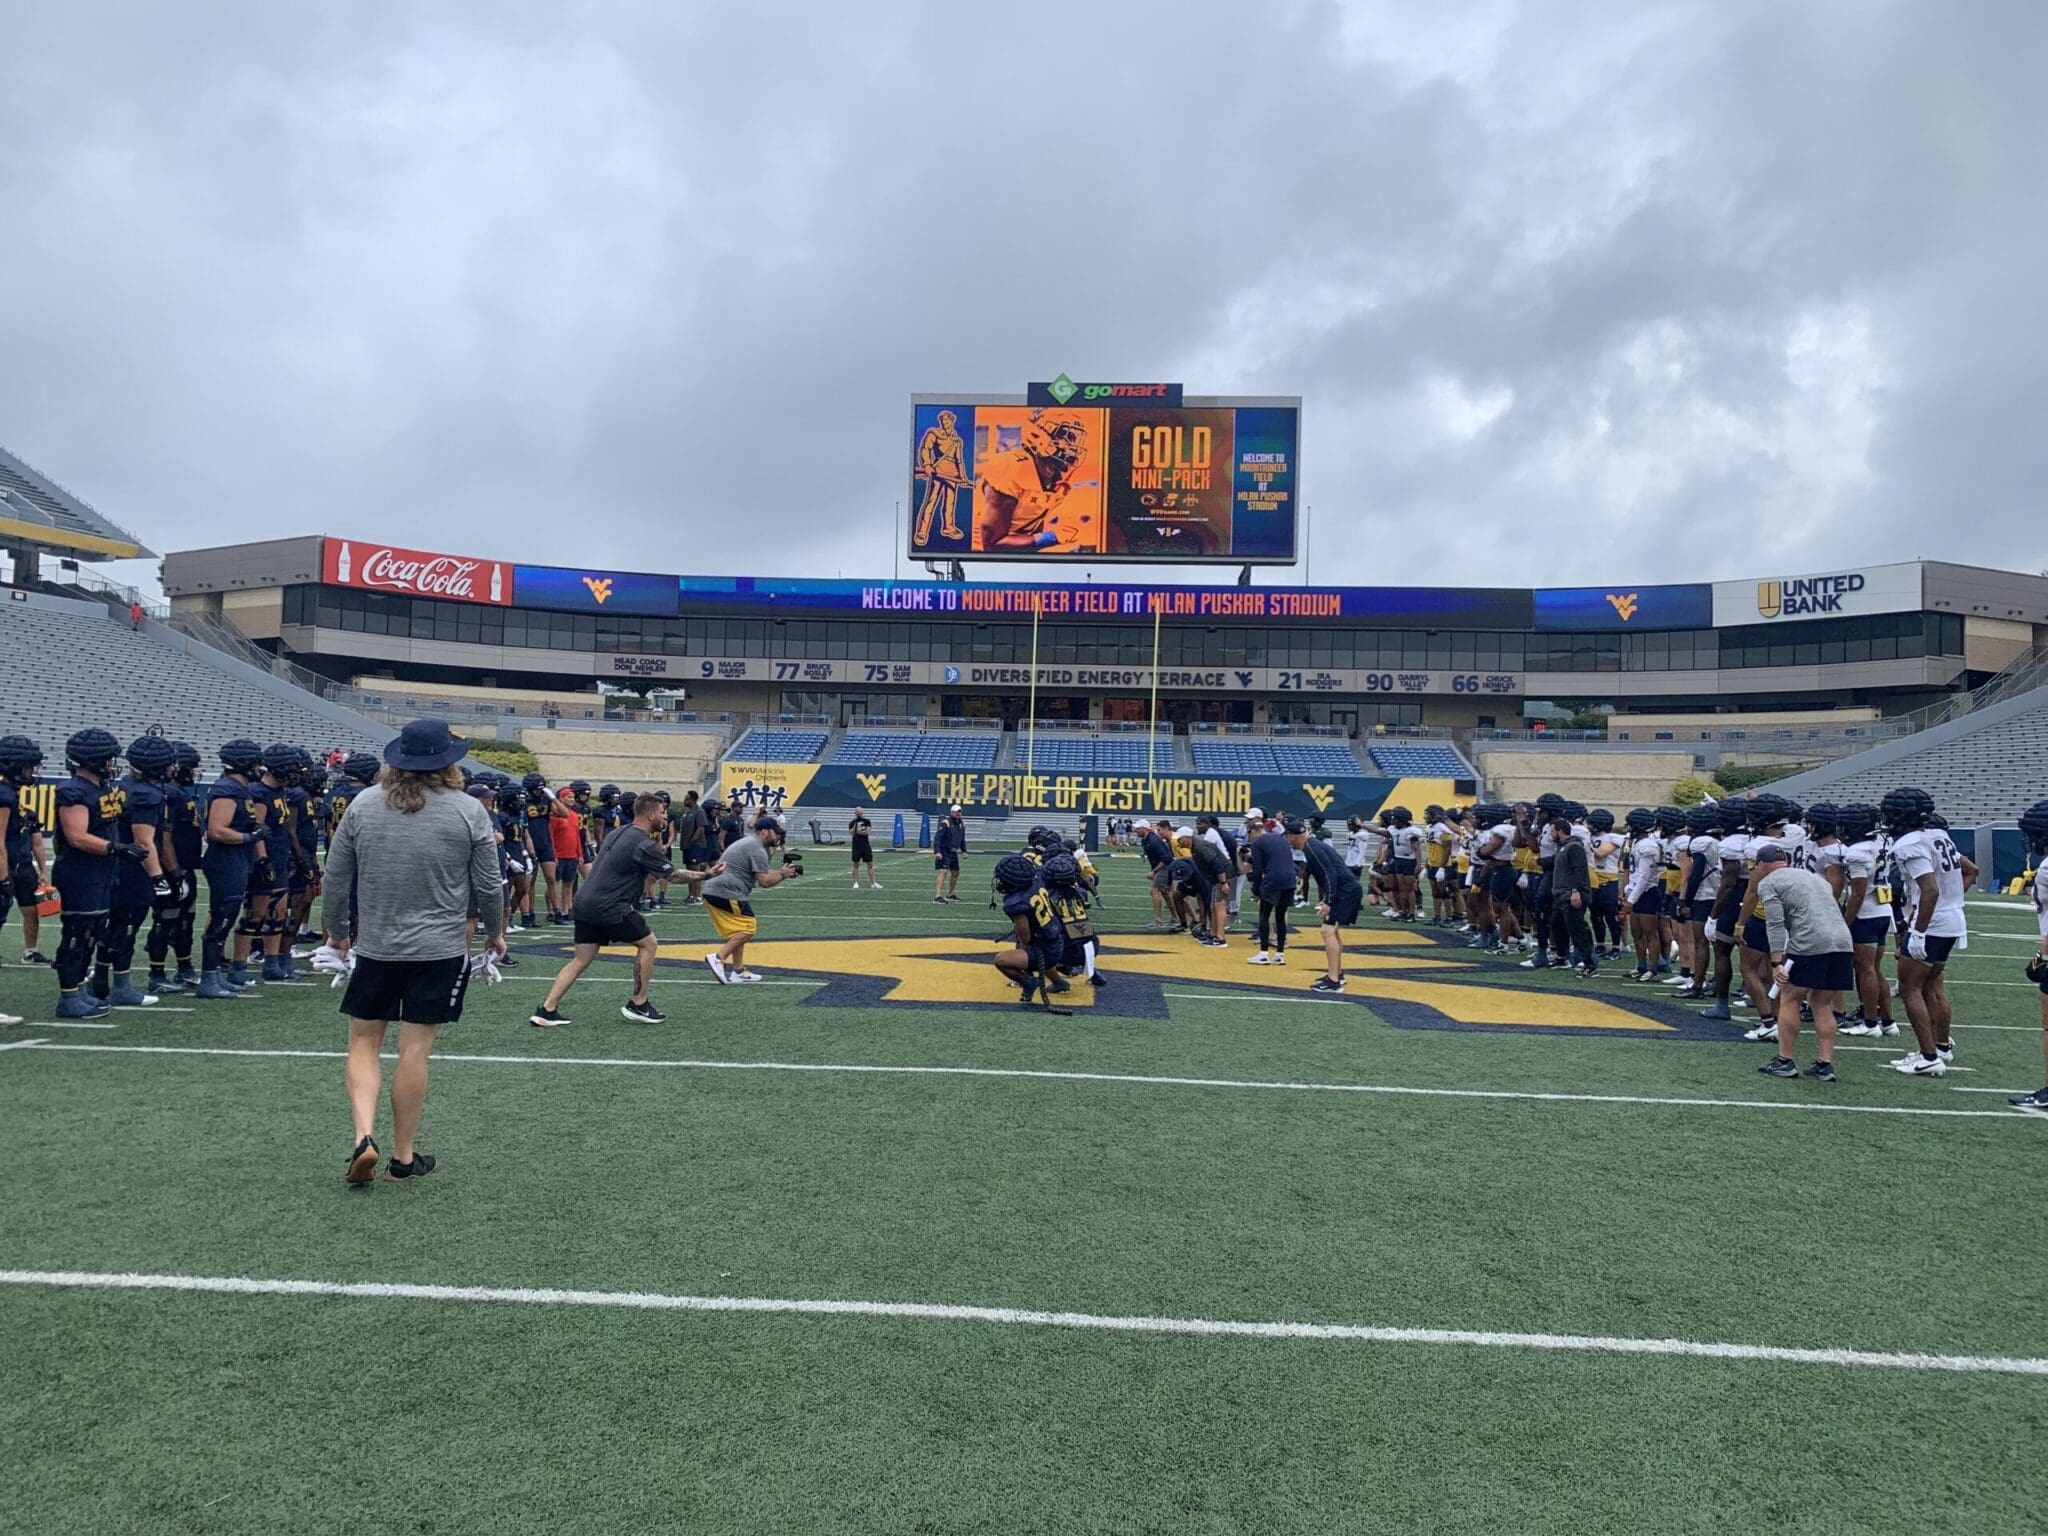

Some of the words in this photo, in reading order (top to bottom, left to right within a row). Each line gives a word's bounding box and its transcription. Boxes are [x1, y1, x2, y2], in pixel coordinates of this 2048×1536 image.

[1083, 384, 1166, 400] gomart
[1132, 425, 1212, 469] GOLD
[1242, 453, 1274, 463] WELCOME
[1276, 453, 1285, 463] TO
[1131, 469, 1211, 490] MINI-PACK
[1253, 472, 1273, 482] FIELD
[1258, 482, 1268, 491] AT
[1237, 491, 1258, 501] MILAN
[1247, 501, 1278, 511] STADIUM
[361, 549, 481, 597] Coca-Cola
[1783, 573, 1865, 598] UNITED
[862, 587, 933, 610] WELCOME
[938, 589, 957, 611] TO
[962, 590, 1070, 612] MOUNTAINEER
[1075, 591, 1118, 613] FIELD
[1123, 592, 1143, 613] AT
[1147, 592, 1196, 614] MILAN
[1201, 593, 1265, 615] PUSKAR
[1270, 594, 1341, 616] STADIUM
[1783, 594, 1843, 616] BANK
[614, 657, 637, 665] HEAD
[639, 658, 667, 667] COACH
[614, 663, 632, 671] DON
[635, 665, 666, 673] NEHLEN
[701, 661, 714, 678] 9
[775, 663, 800, 680] 77
[804, 669, 833, 677] BOSLEY
[864, 664, 889, 682] 75
[971, 668, 1072, 684] DIVERSFIED
[1078, 670, 1143, 685] ENERGY
[1148, 671, 1226, 687] TERRACE
[1398, 674, 1430, 682] DARRYL
[1486, 675, 1514, 683] CHUCK
[1278, 672, 1302, 689] 21
[1366, 673, 1393, 691] 90
[1399, 680, 1429, 688] TALLEY
[1452, 675, 1479, 692] 66
[936, 773, 978, 804] THE
[981, 774, 1050, 807] PRIDE
[1055, 776, 1084, 808] OF
[1087, 777, 1146, 811] WEST
[1151, 778, 1251, 812] VIRGINIA
[1933, 838, 1963, 873] 32
